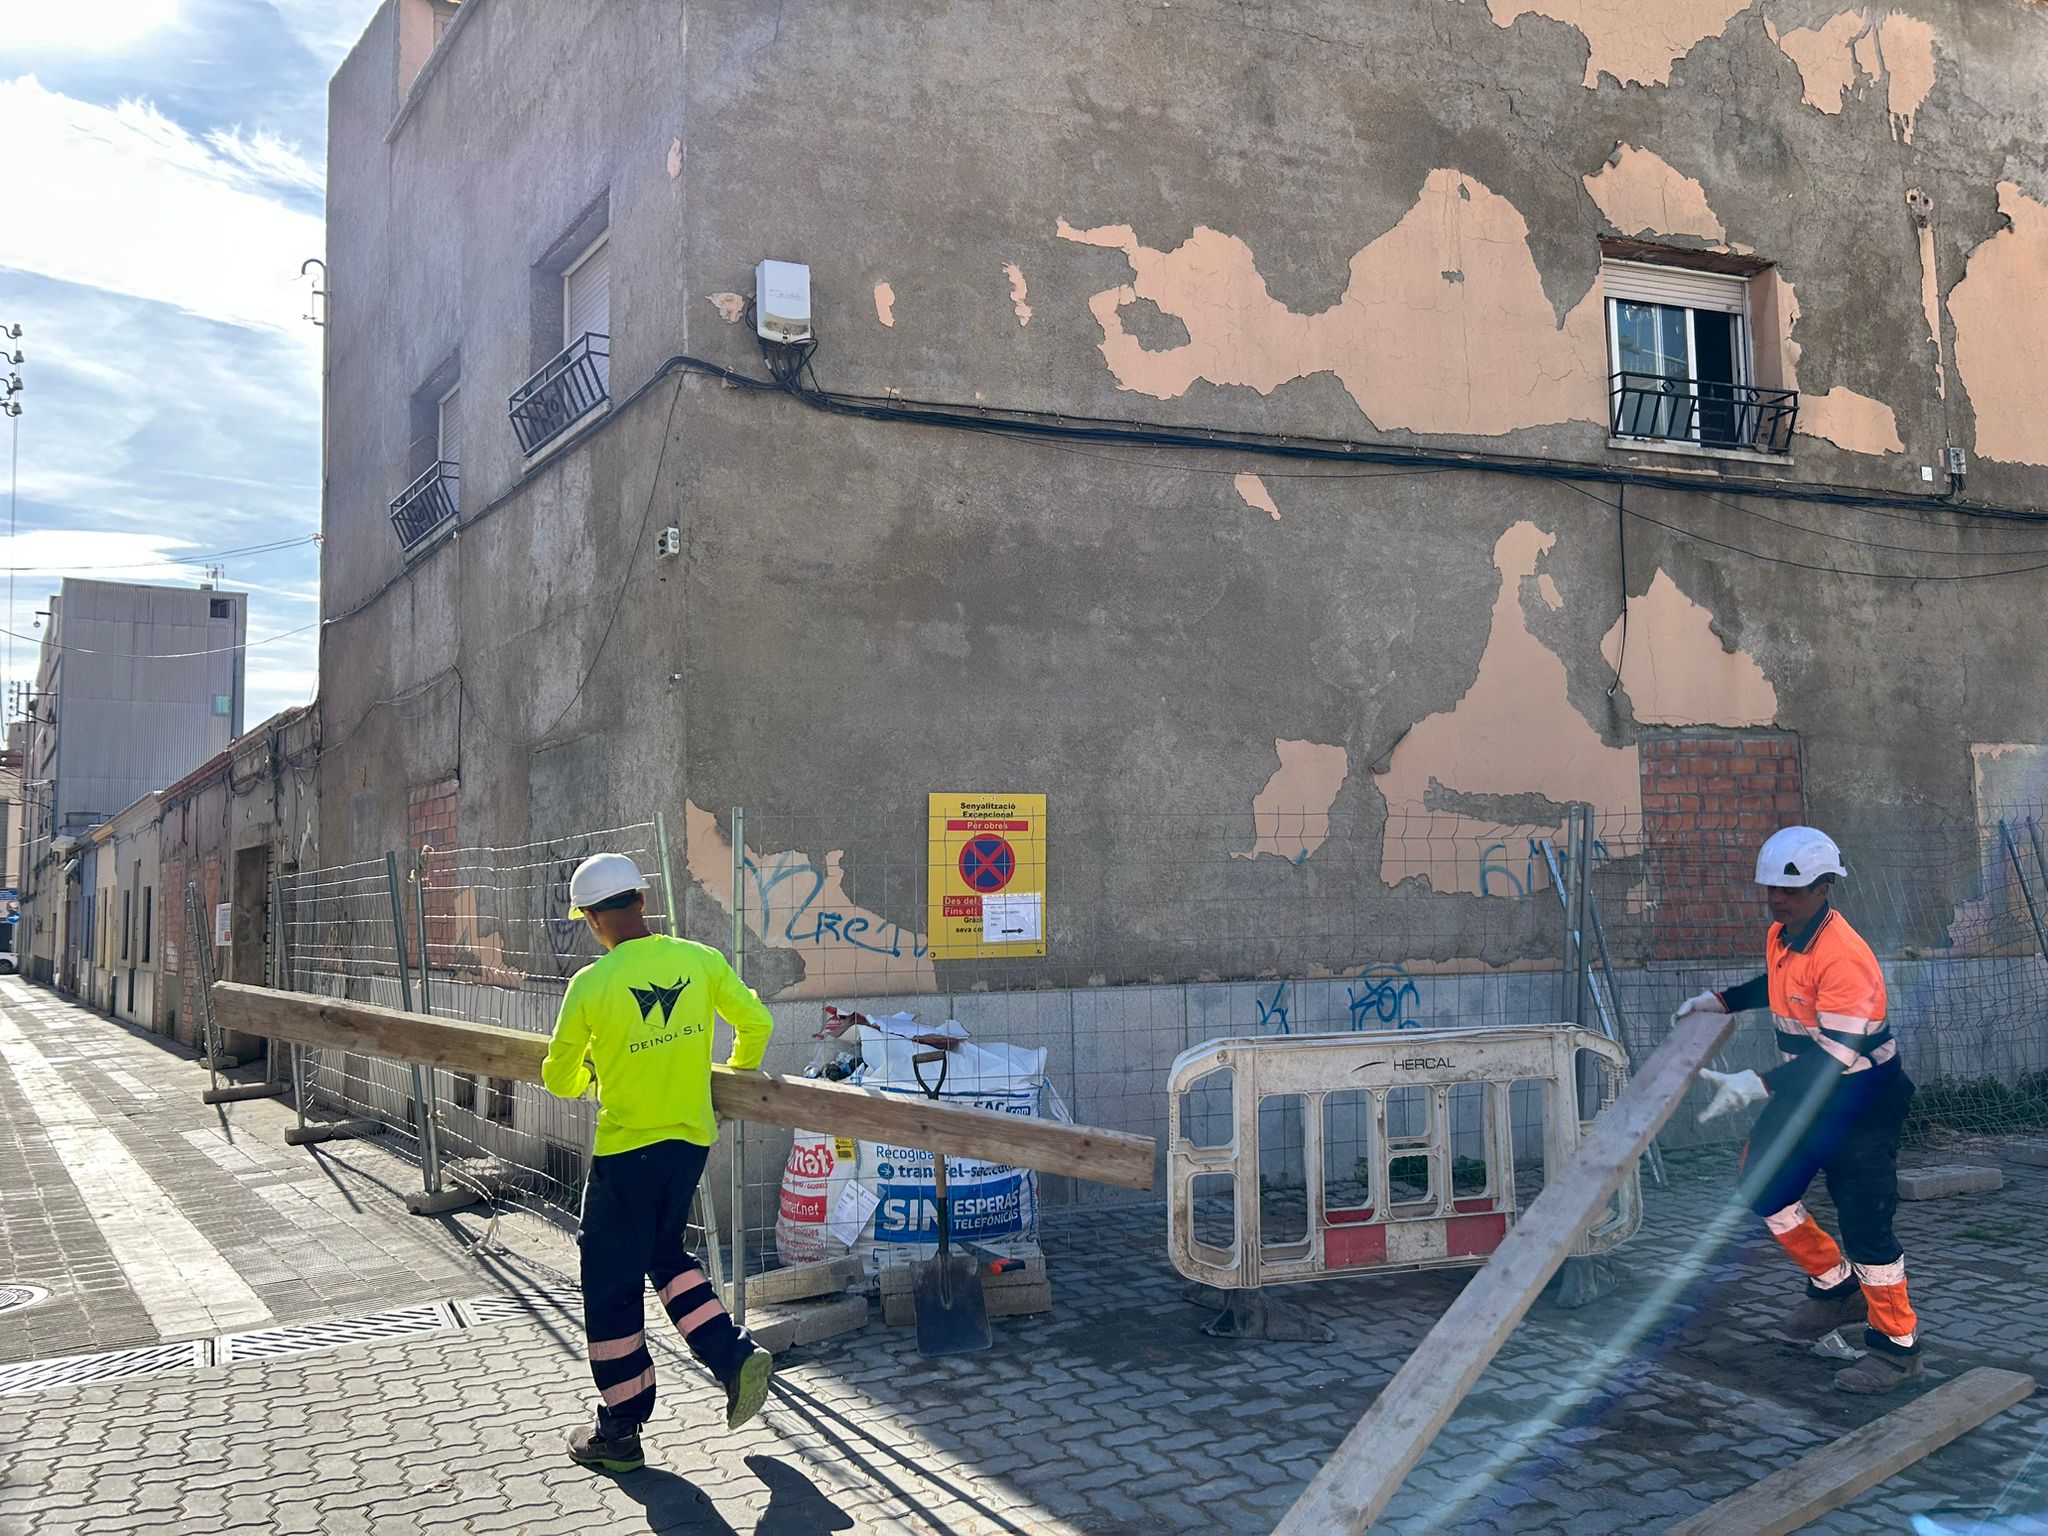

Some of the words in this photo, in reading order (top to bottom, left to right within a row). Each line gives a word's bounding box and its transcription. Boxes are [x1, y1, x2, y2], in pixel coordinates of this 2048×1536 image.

[960, 802, 1016, 811] Senyalització
[962, 811, 1014, 819] Excepcional
[967, 821, 981, 829] Per
[983, 821, 1008, 830] obres
[944, 897, 961, 905] Des
[944, 907, 963, 916] Fins
[1393, 1057, 1456, 1071] HERCAL
[953, 1190, 1019, 1216] ESPERAS
[953, 1208, 1019, 1230] TELEFÓNICAS
